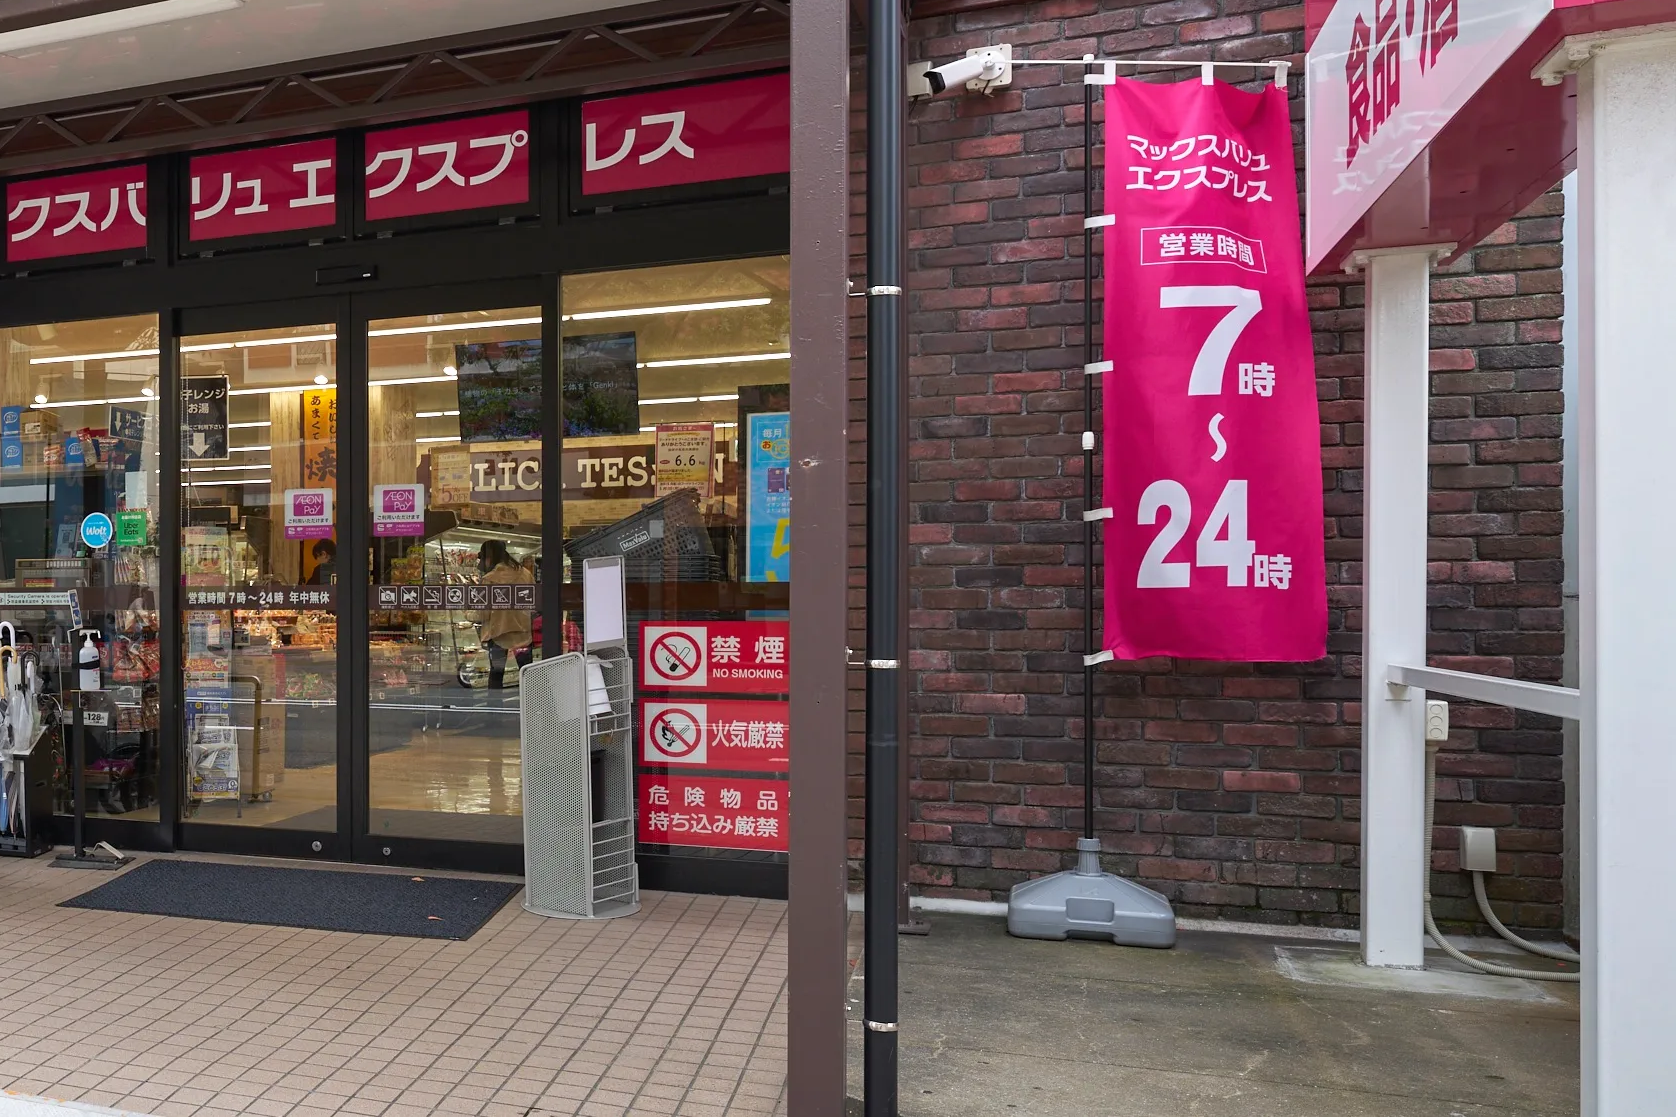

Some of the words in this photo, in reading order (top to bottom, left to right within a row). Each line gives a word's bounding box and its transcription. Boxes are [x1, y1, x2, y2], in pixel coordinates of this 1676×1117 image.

[1126, 131, 1271, 173] マックスバリュ
[1125, 163, 1274, 203] エクスプレス
[1158, 232, 1254, 267] 営業時間
[181, 388, 226, 401] 子レンジ
[188, 402, 209, 414] お湯
[310, 395, 322, 441] あまくて
[675, 455, 696, 467] 6.6
[304, 505, 321, 515] Pay
[394, 501, 412, 512] Pay
[86, 526, 107, 536] Wolt
[1136, 479, 1292, 590] 24時
[623, 533, 648, 549] MaxValu
[188, 592, 226, 605] 営業時間
[289, 590, 330, 605] 年中無休
[711, 635, 785, 664] 禁煙
[712, 668, 729, 678] NO
[731, 669, 783, 680] SMOKING
[87, 713, 101, 721] 128
[711, 719, 784, 749] 火気厳禁
[648, 784, 778, 811] 危険物品
[648, 810, 778, 838] 持ち込み厳禁
